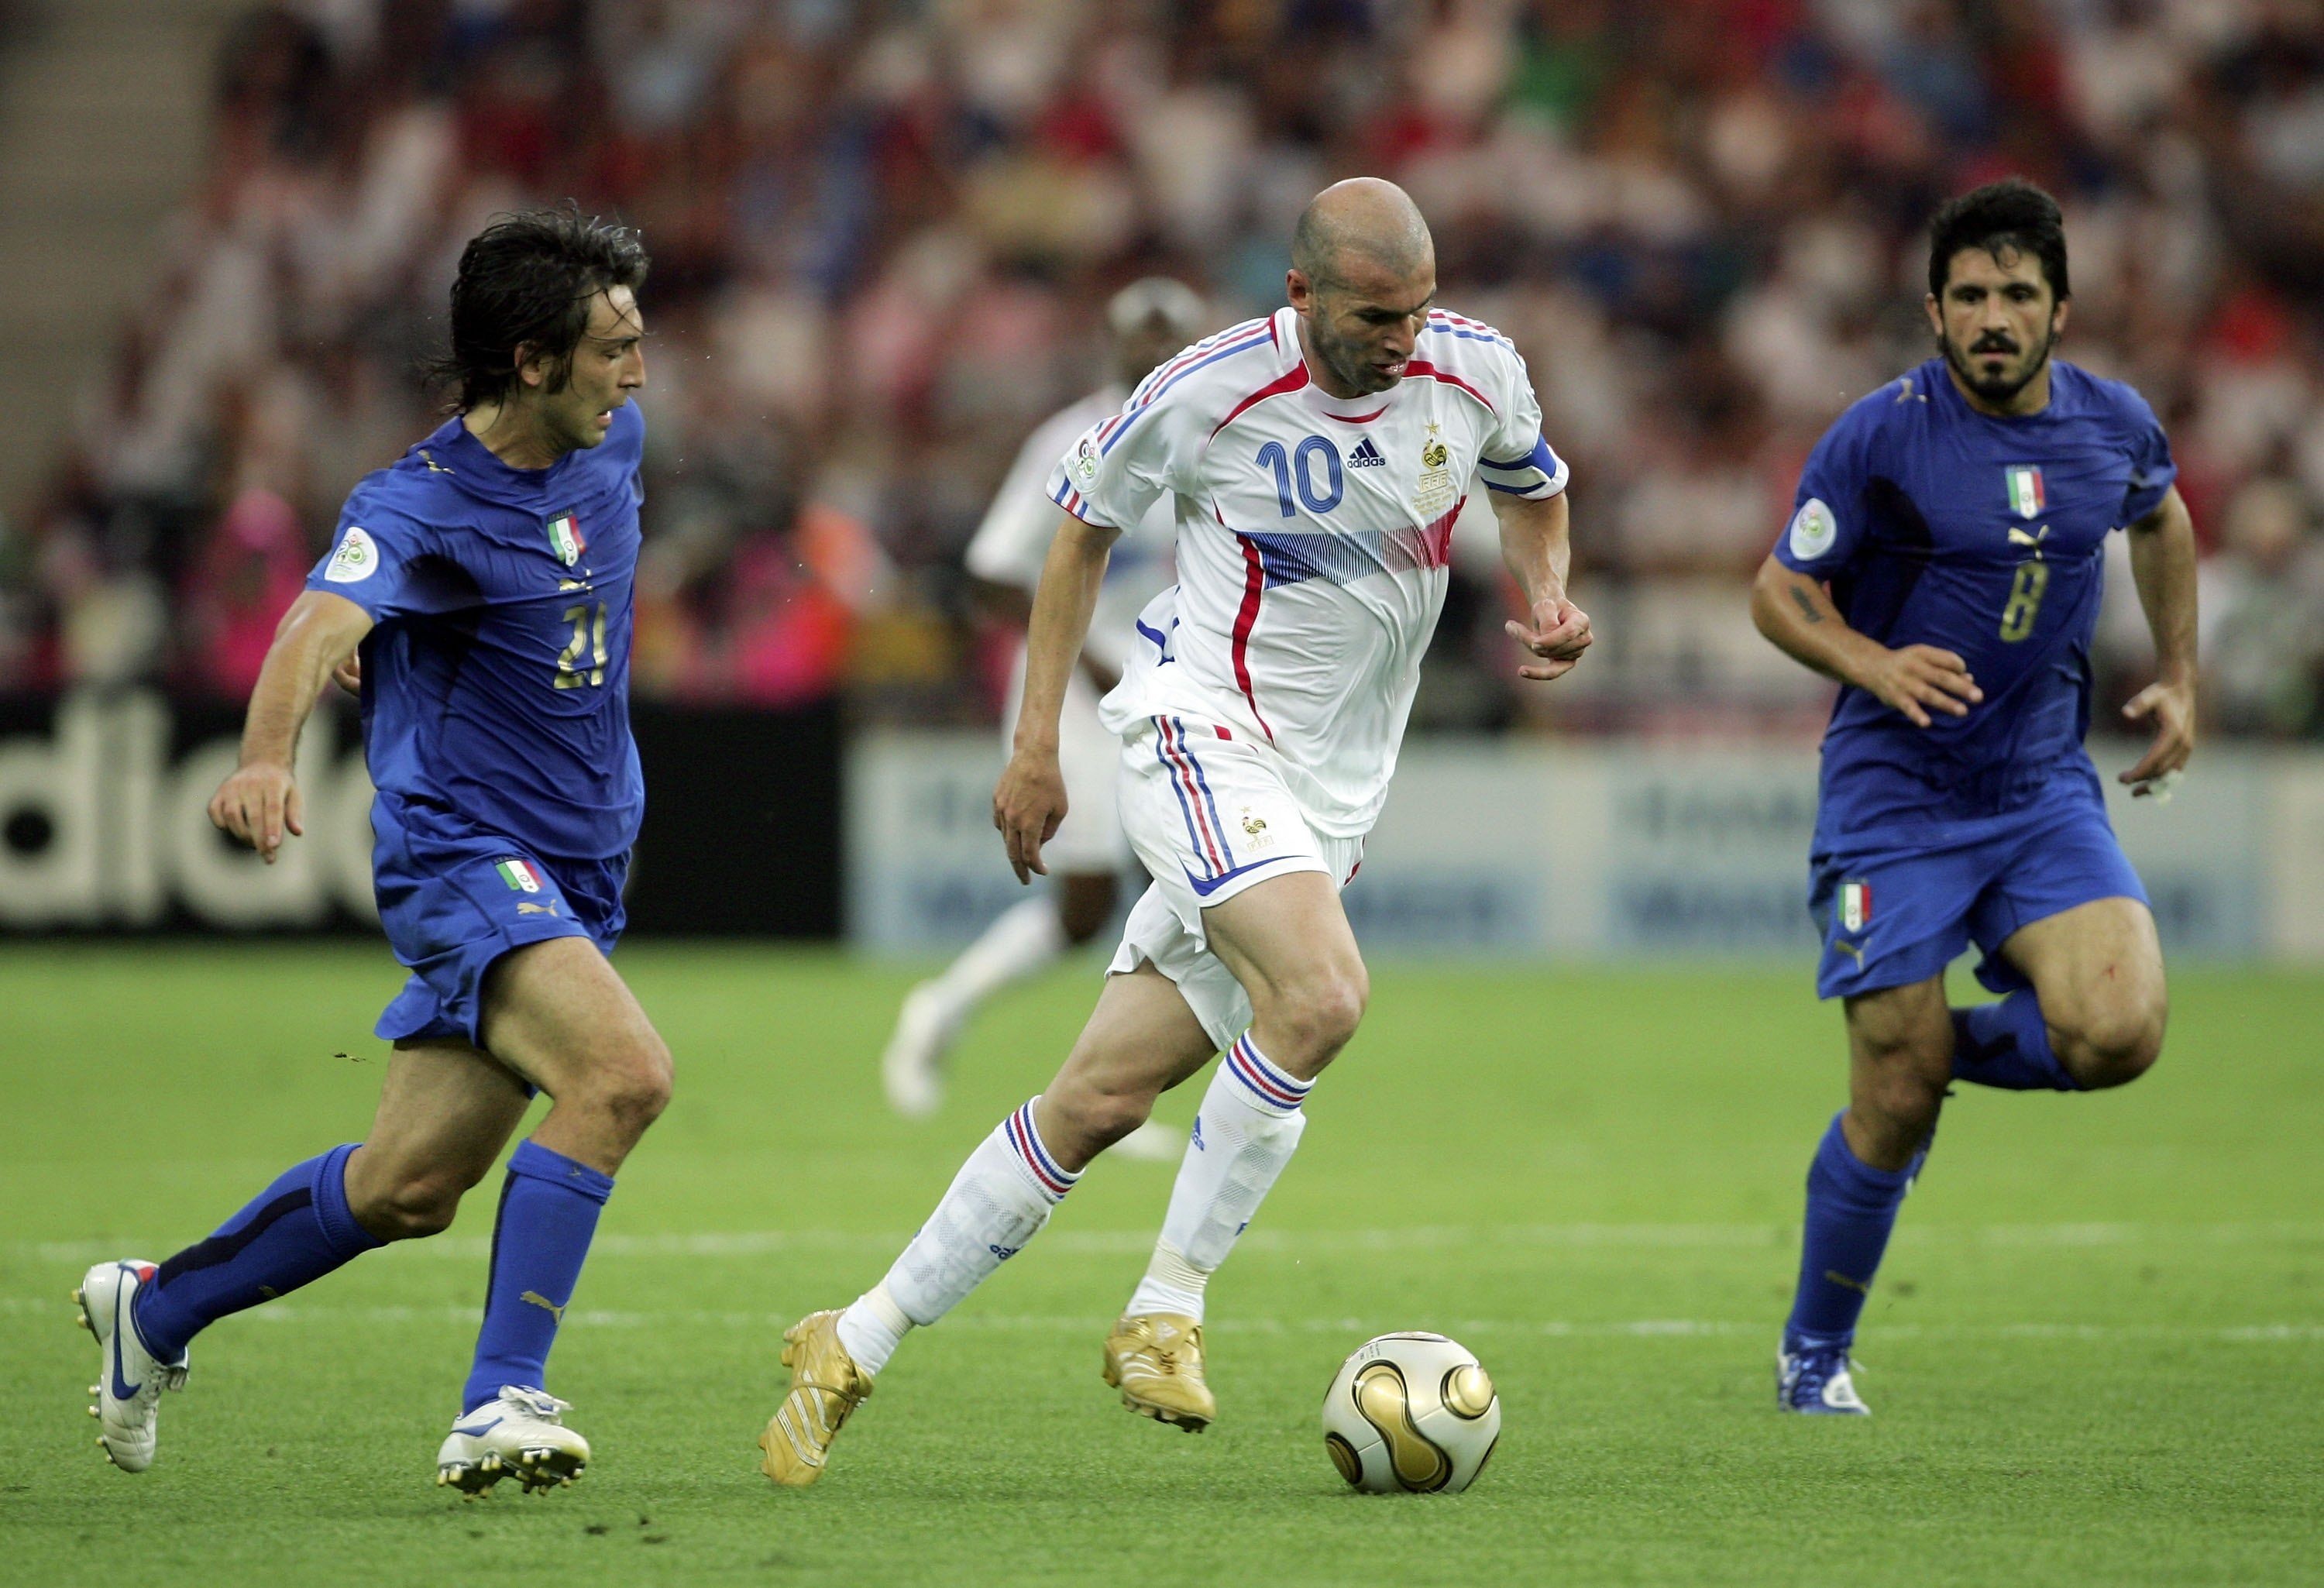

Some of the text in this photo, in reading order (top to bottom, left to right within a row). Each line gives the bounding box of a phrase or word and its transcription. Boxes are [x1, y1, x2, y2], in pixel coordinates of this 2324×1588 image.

[1255, 435, 1343, 517] 10
[1347, 457, 1386, 469] adidas
[548, 508, 573, 521] ITALIA
[1999, 560, 2049, 642] 8
[553, 599, 607, 689] 21
